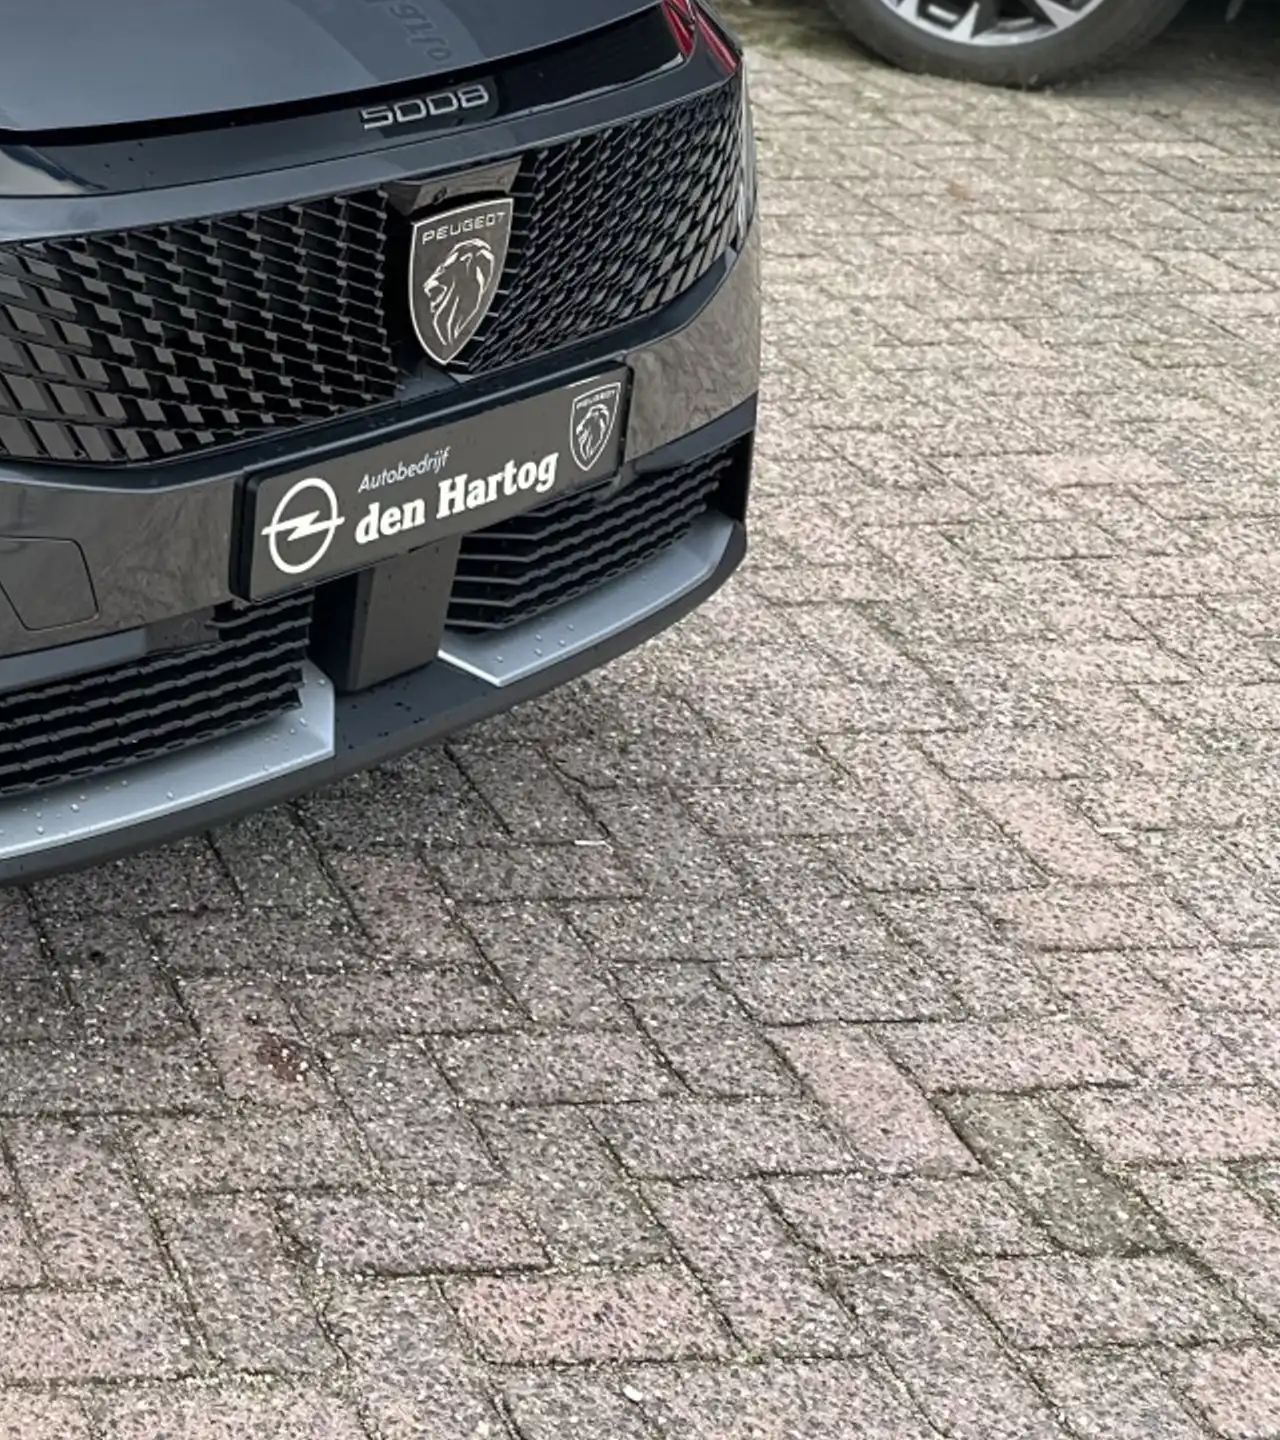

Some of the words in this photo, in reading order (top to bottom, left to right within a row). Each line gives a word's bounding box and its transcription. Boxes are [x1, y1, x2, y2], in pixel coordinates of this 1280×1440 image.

[361, 84, 489, 130] 5008
[422, 212, 505, 245] PEUGEOT
[358, 446, 451, 494] Autobedrijf
[355, 501, 426, 544] den
[436, 452, 559, 520] Hartog
